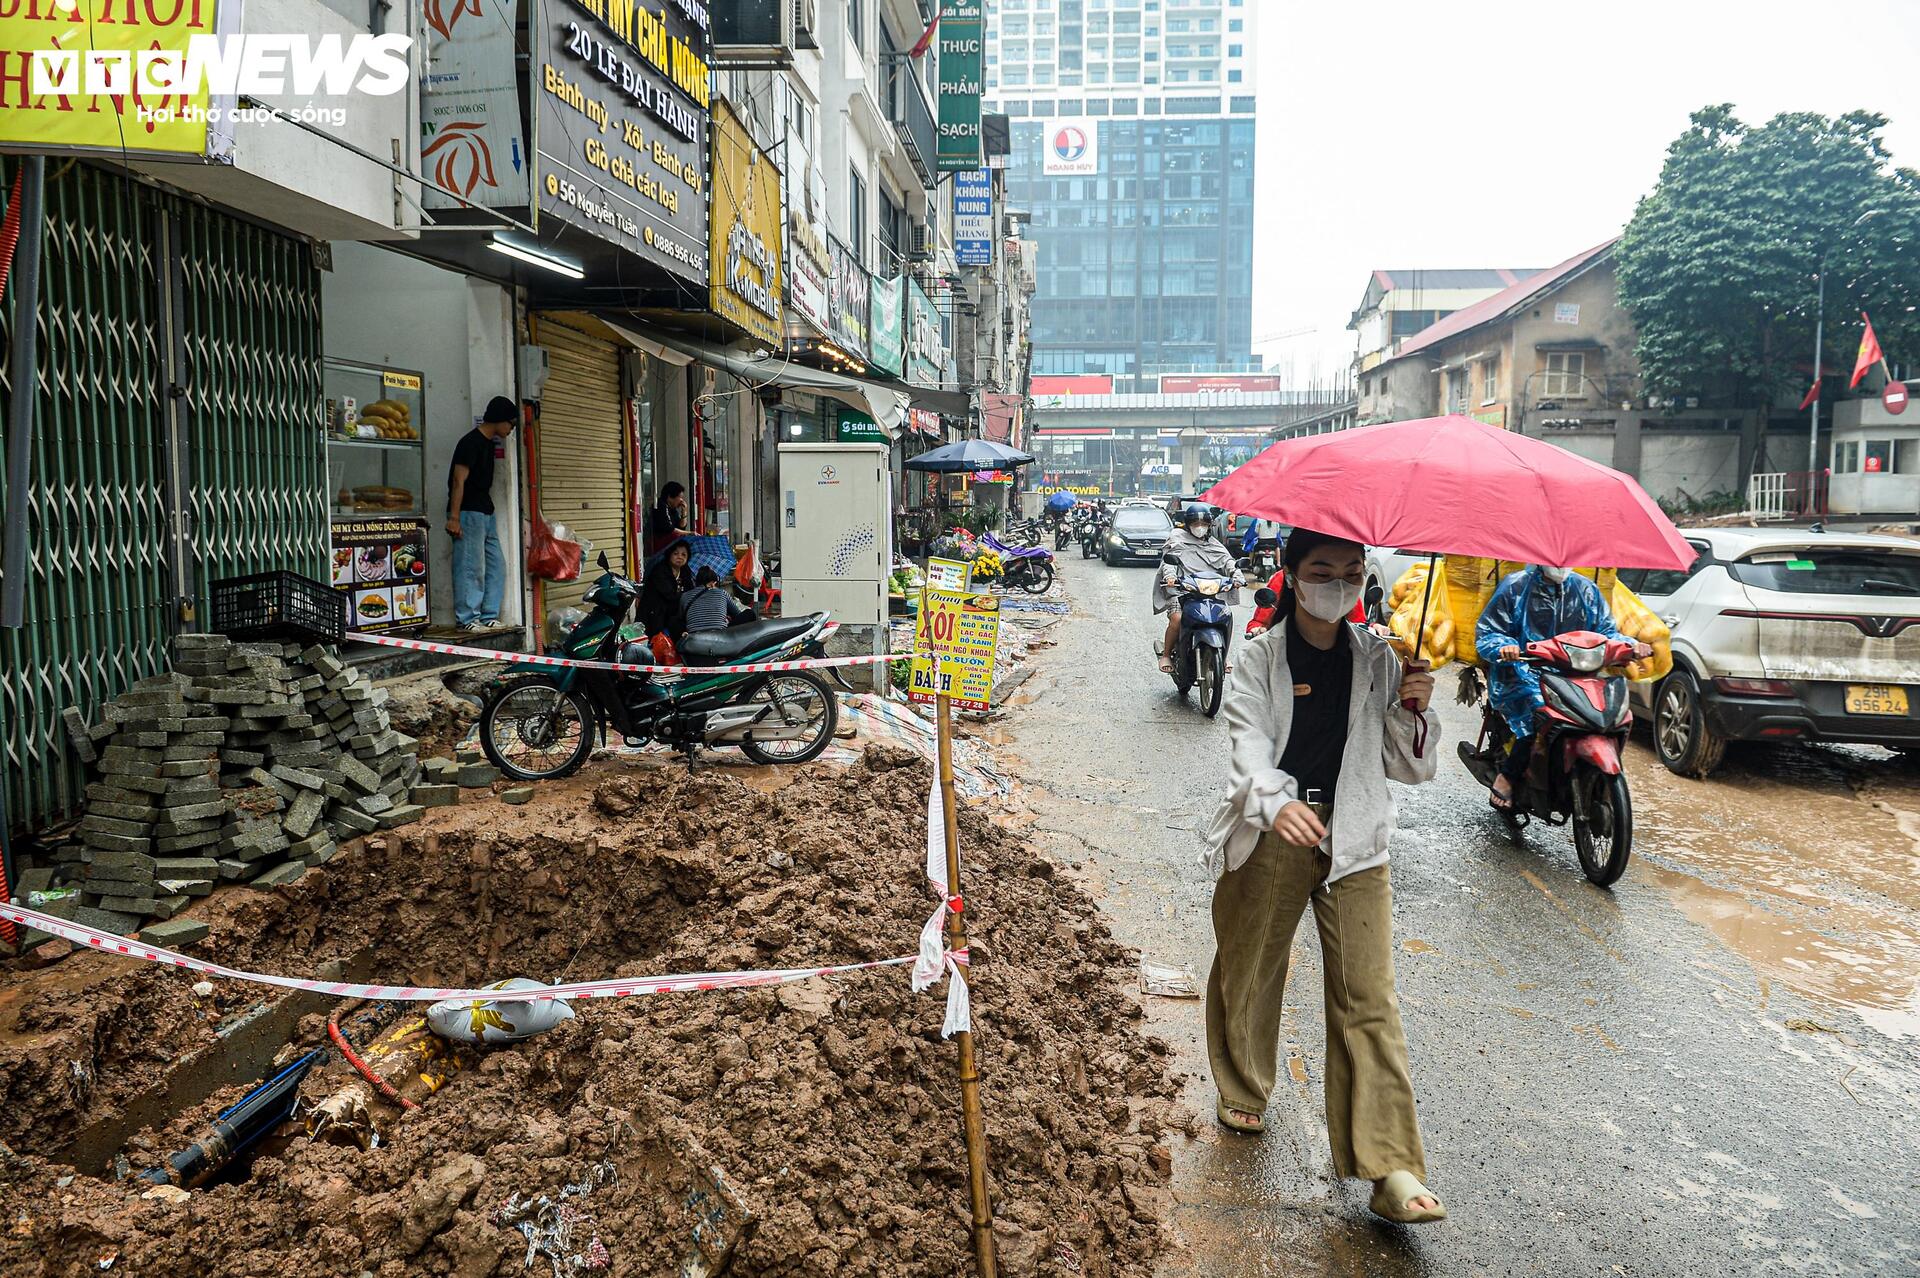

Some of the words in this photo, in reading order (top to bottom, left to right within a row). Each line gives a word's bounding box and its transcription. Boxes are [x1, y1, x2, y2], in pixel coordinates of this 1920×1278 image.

[941, 40, 979, 56] THỰC
[637, 6, 669, 77] CHẢ
[672, 35, 709, 109] NÓNG
[570, 21, 592, 61] 20
[597, 41, 618, 83] LÊ
[622, 60, 651, 108] ĐẠI
[655, 88, 698, 144] HÀNH
[940, 75, 979, 94] PHẨM
[543, 63, 584, 113] Bánh
[587, 98, 609, 134] mỳ
[623, 118, 643, 152] Xôi
[652, 139, 682, 178] Bánh
[683, 160, 703, 195] dày
[940, 124, 978, 140] SẠCH
[585, 138, 609, 171] Giò
[611, 156, 635, 188] chả
[636, 171, 657, 201] các
[658, 182, 678, 217] loại
[960, 171, 986, 184] GẠCH
[955, 185, 990, 198] KHÔNG
[958, 202, 987, 213] NUNG
[559, 179, 576, 205] 56
[616, 212, 638, 238] Tuân
[654, 233, 674, 257] 0886
[675, 245, 689, 264] 956
[689, 254, 703, 271] 456
[956, 230, 989, 239] KHANG
[1151, 466, 1169, 474] ACB
[1037, 486, 1063, 494] GOLD
[1066, 486, 1100, 495] TOWER
[920, 602, 955, 641] XÔI
[970, 648, 991, 657] KHOAI
[1864, 687, 1889, 699] 29H
[1854, 700, 1901, 711] 956.24
